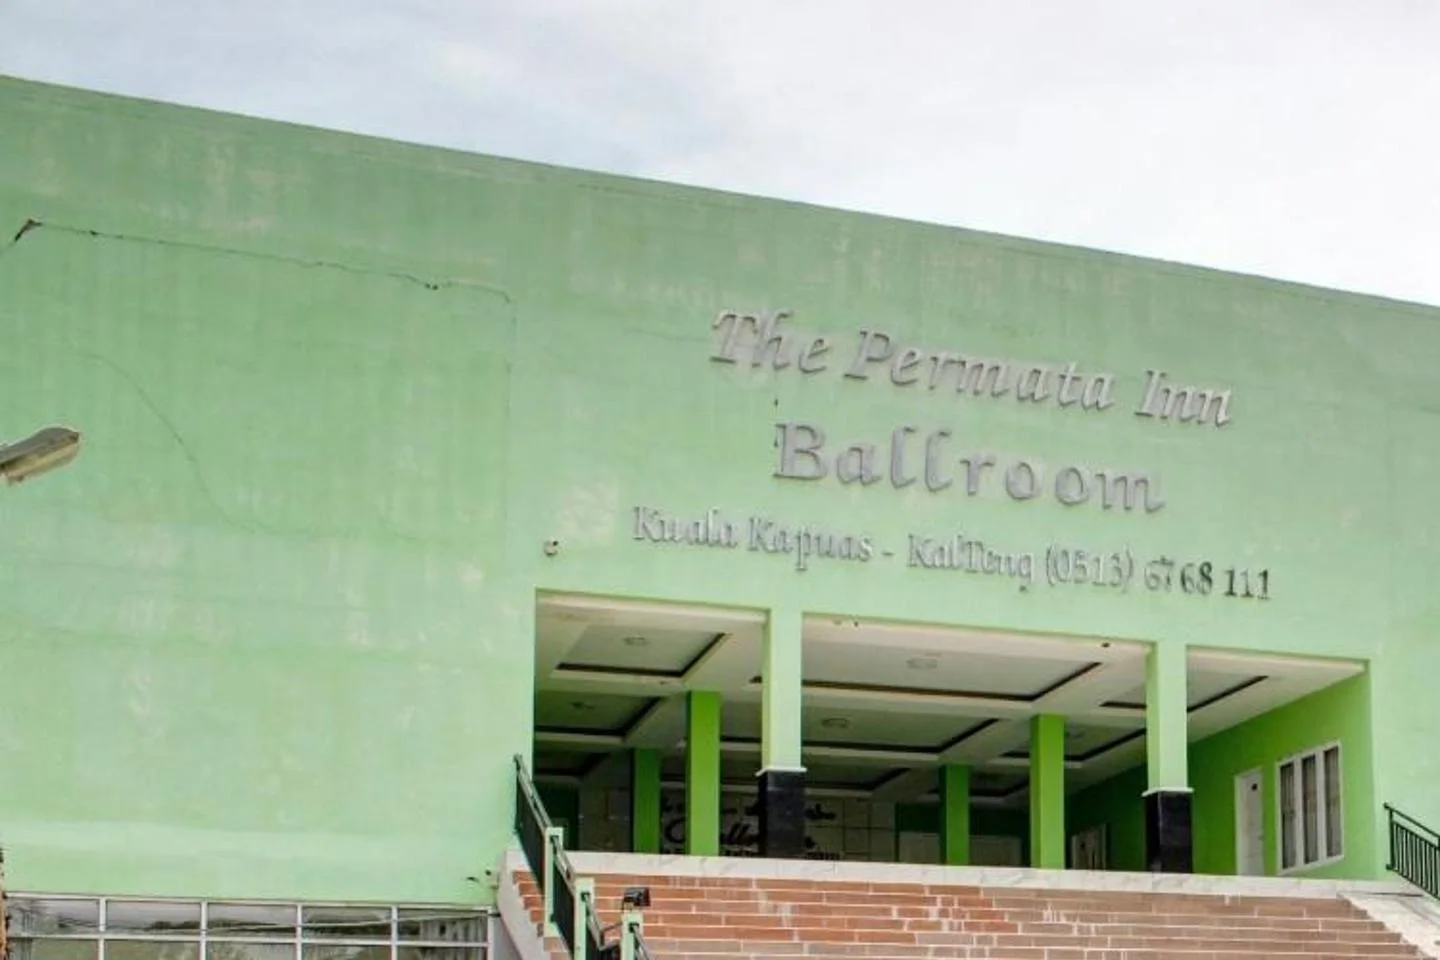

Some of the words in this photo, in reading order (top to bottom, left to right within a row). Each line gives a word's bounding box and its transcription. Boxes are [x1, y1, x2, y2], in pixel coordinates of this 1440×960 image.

[709, 308, 831, 374] The
[842, 327, 1117, 413] Permata
[1133, 369, 1232, 427] Inn
[772, 420, 1164, 514] Ballroom
[632, 505, 738, 549] Kuala
[747, 515, 873, 572] Kapuas
